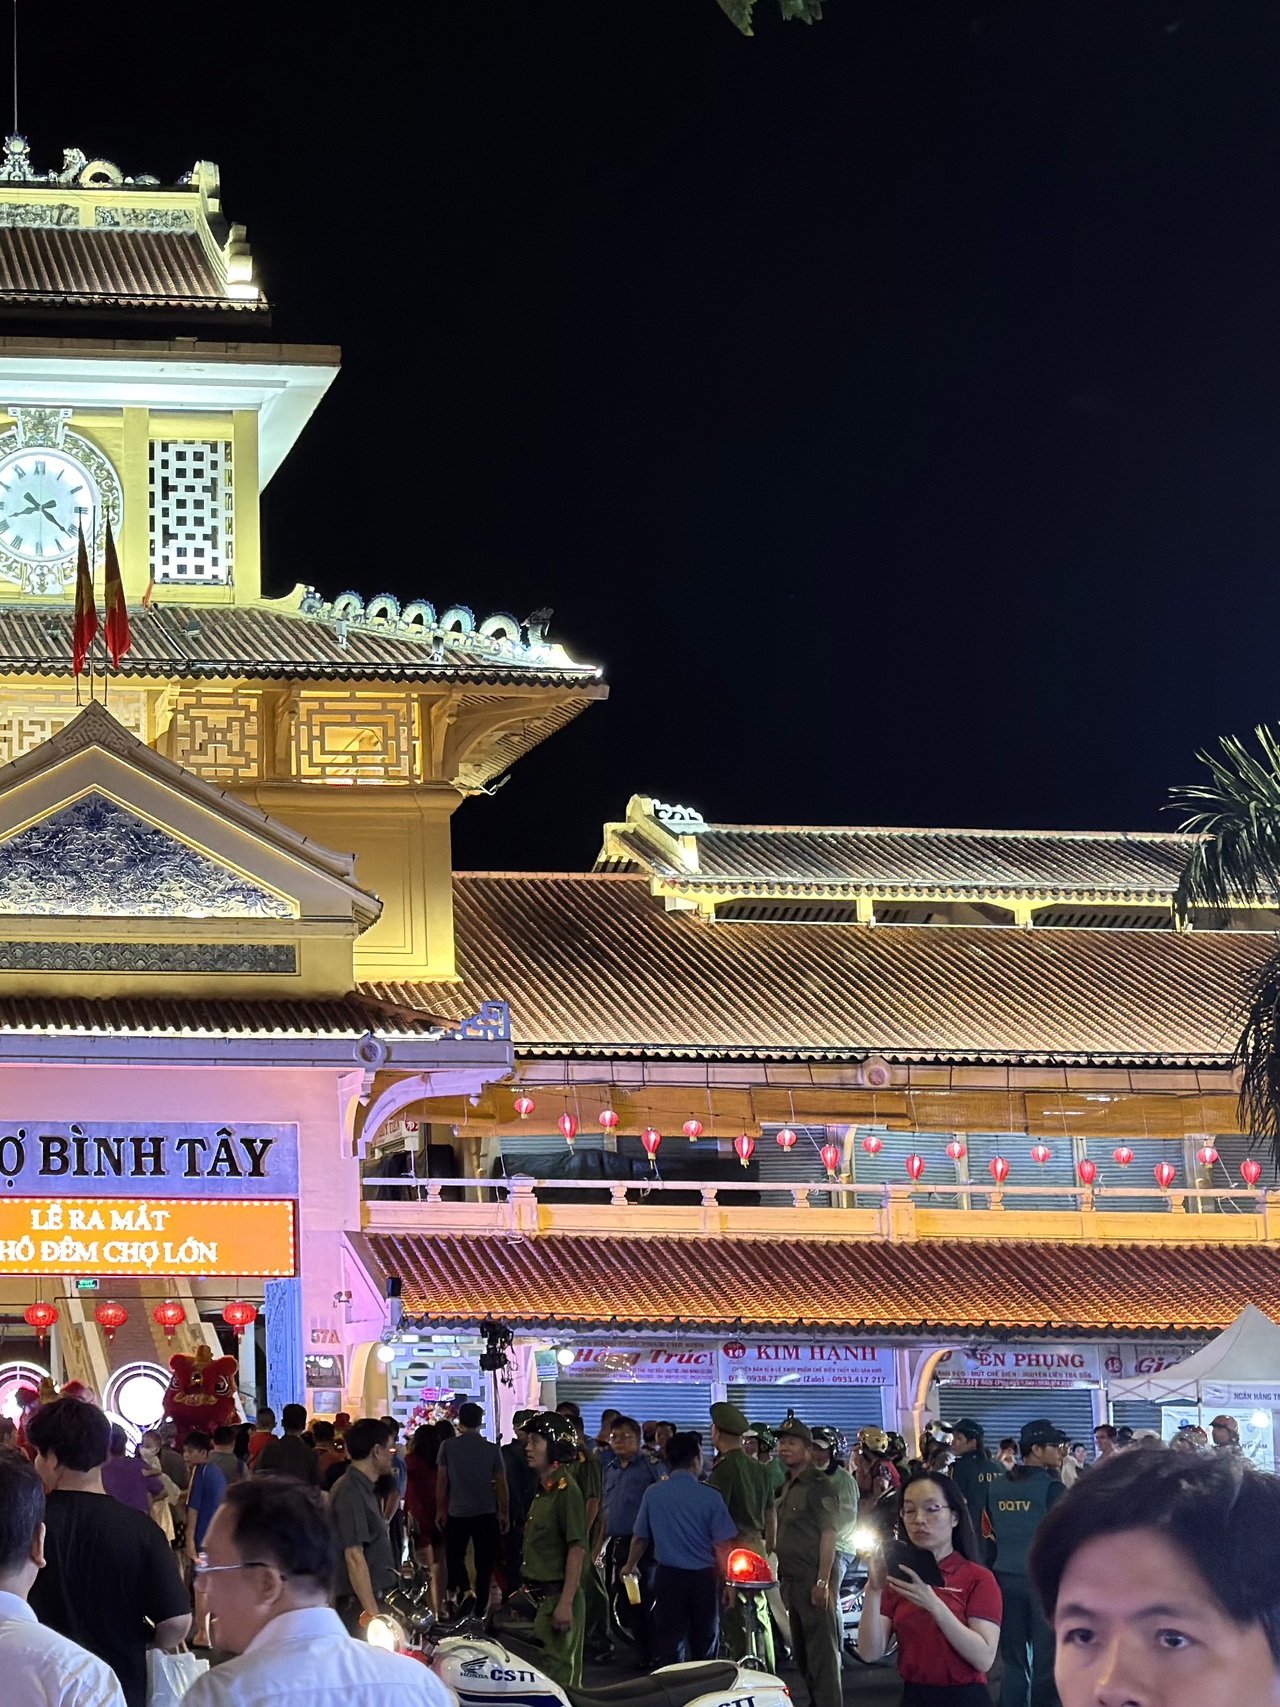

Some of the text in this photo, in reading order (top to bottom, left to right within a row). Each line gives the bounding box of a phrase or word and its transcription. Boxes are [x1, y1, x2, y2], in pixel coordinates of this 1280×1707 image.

[38, 1125, 168, 1178] BÌNH
[175, 1127, 276, 1179] TÂY
[68, 1209, 105, 1231] RA
[103, 1240, 160, 1268] CHỢ
[311, 1328, 341, 1344] 57A
[650, 1349, 708, 1365] Trúc
[756, 1345, 878, 1365] KIM HẠNH
[964, 1346, 1085, 1371] ẾN PHỤNG
[998, 1500, 1031, 1511] DQTV
[460, 1672, 489, 1680] HONDA
[490, 1669, 535, 1683] CSTT
